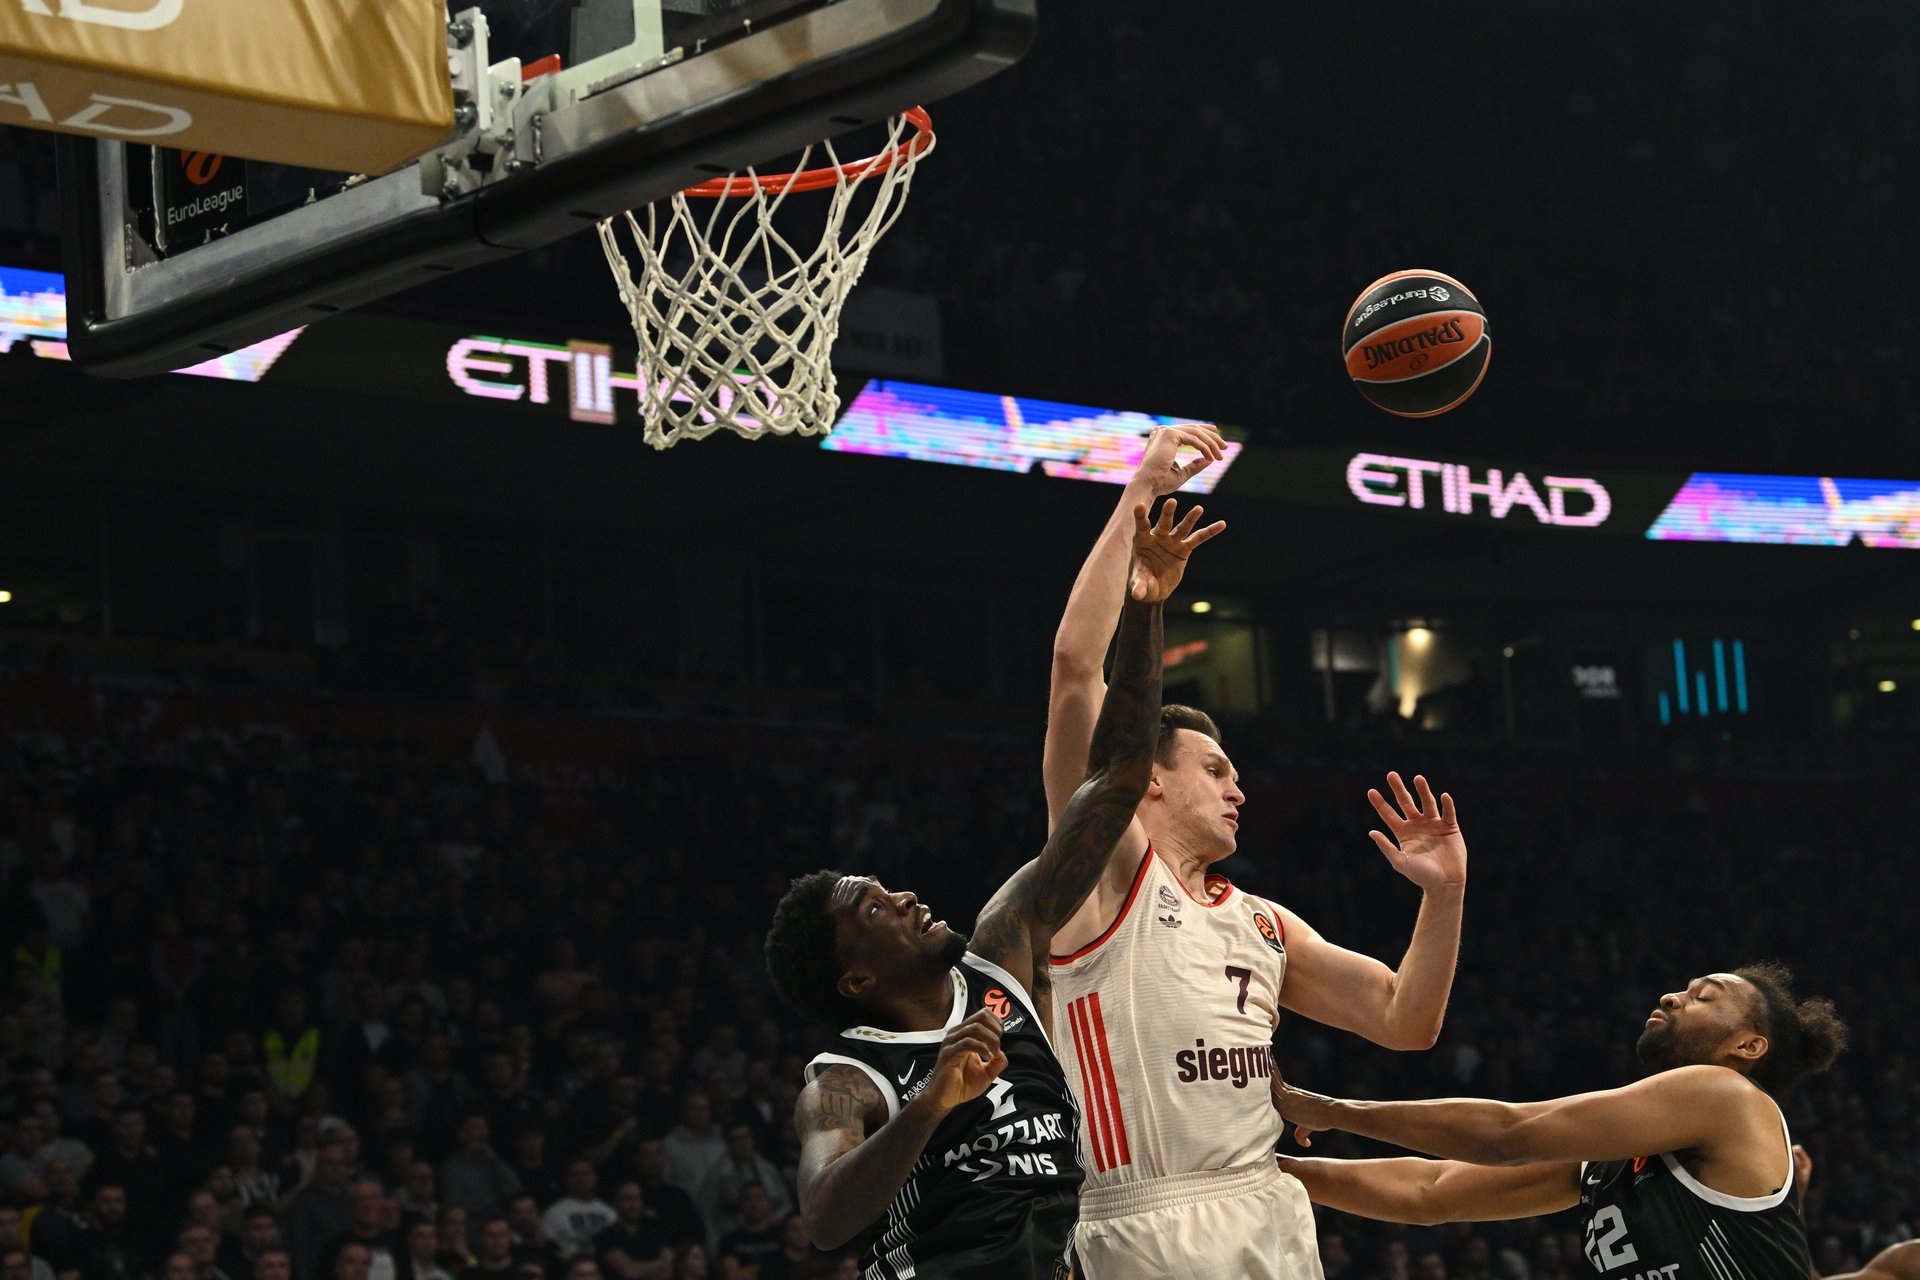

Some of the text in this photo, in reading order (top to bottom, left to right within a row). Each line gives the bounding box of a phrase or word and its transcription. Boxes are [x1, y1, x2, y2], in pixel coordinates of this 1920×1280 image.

[167, 185, 243, 226] EuroLeague
[1354, 289, 1428, 327] EuroLeague
[1363, 317, 1465, 370] SPALDING
[1346, 452, 1612, 527] ETIHAD
[1225, 965, 1252, 1015] 7
[944, 1113, 1066, 1168] MOZZART
[1007, 1152, 1059, 1176] NIS
